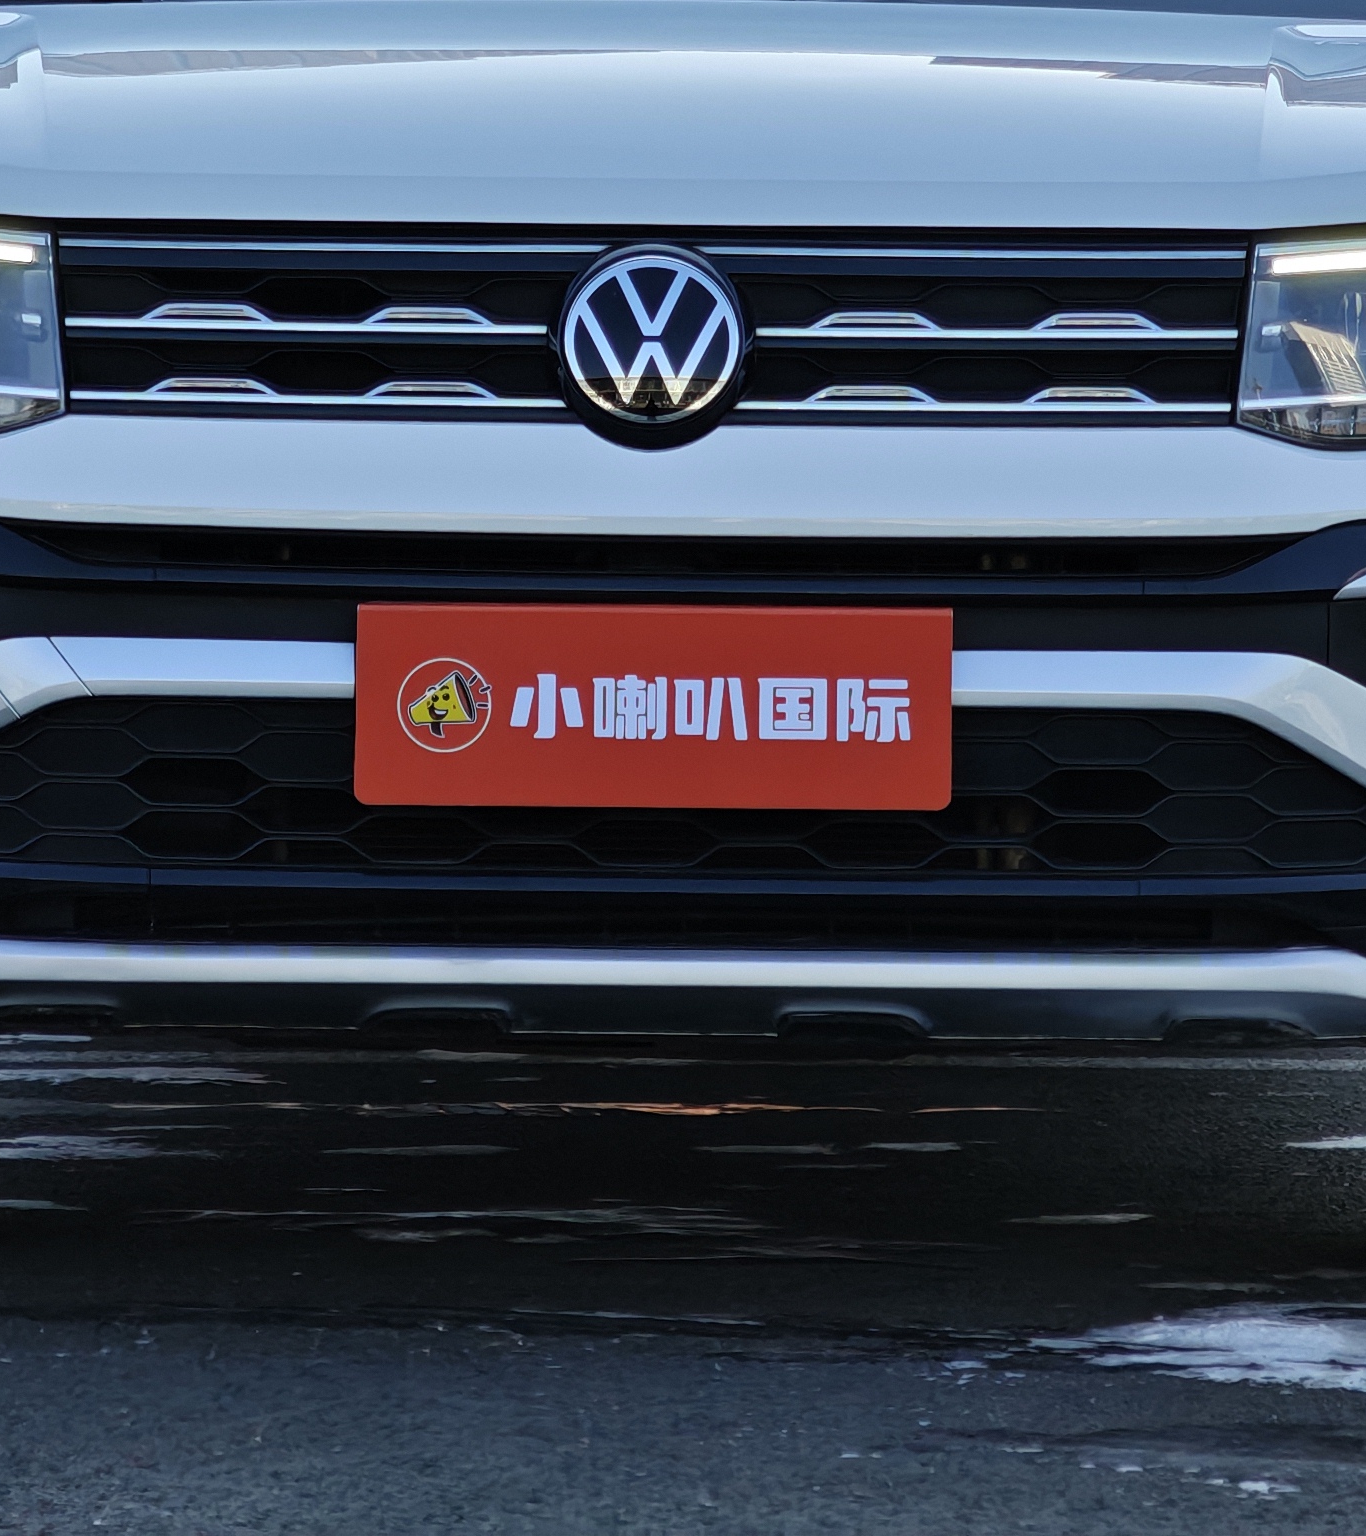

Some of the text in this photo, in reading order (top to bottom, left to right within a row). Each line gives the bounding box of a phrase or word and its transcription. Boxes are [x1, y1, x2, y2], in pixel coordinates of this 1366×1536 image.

[509, 674, 911, 742] 小喇叭国际
